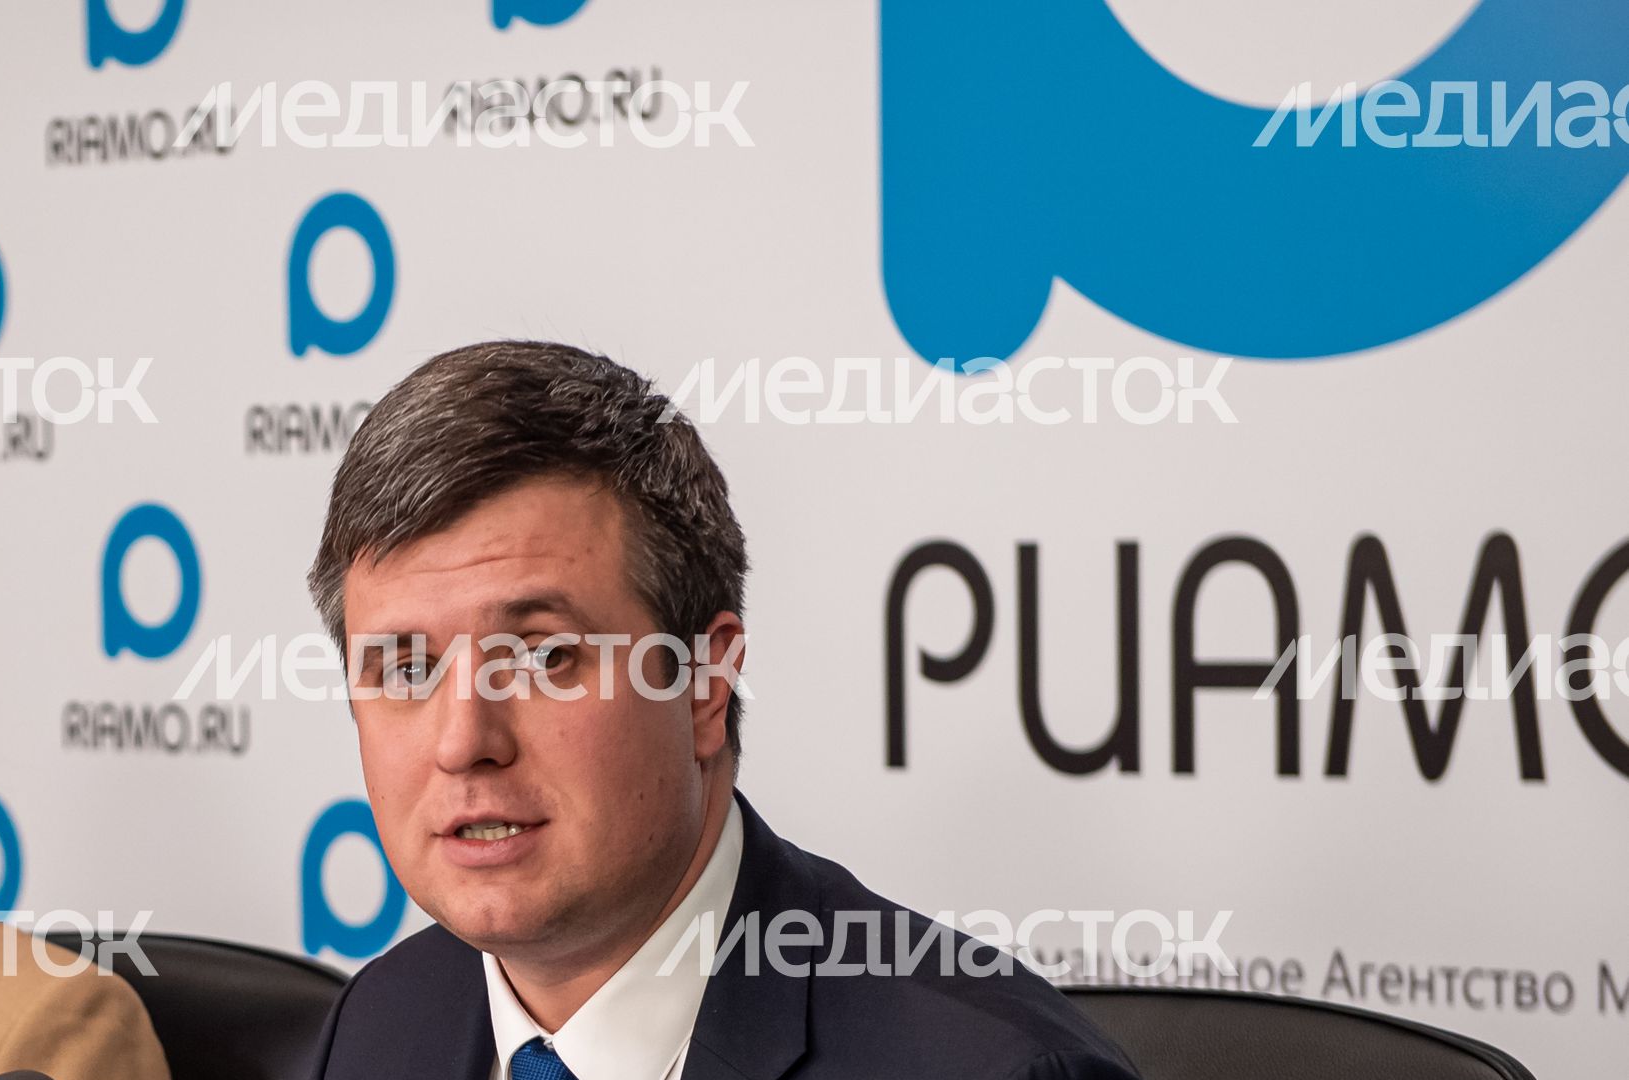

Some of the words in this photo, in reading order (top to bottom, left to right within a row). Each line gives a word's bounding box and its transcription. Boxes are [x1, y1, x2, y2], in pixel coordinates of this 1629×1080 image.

[46, 104, 237, 168] RIAMO.RU
[62, 701, 251, 756] RIAMO.RU
[1322, 947, 1575, 1013] Агентство
